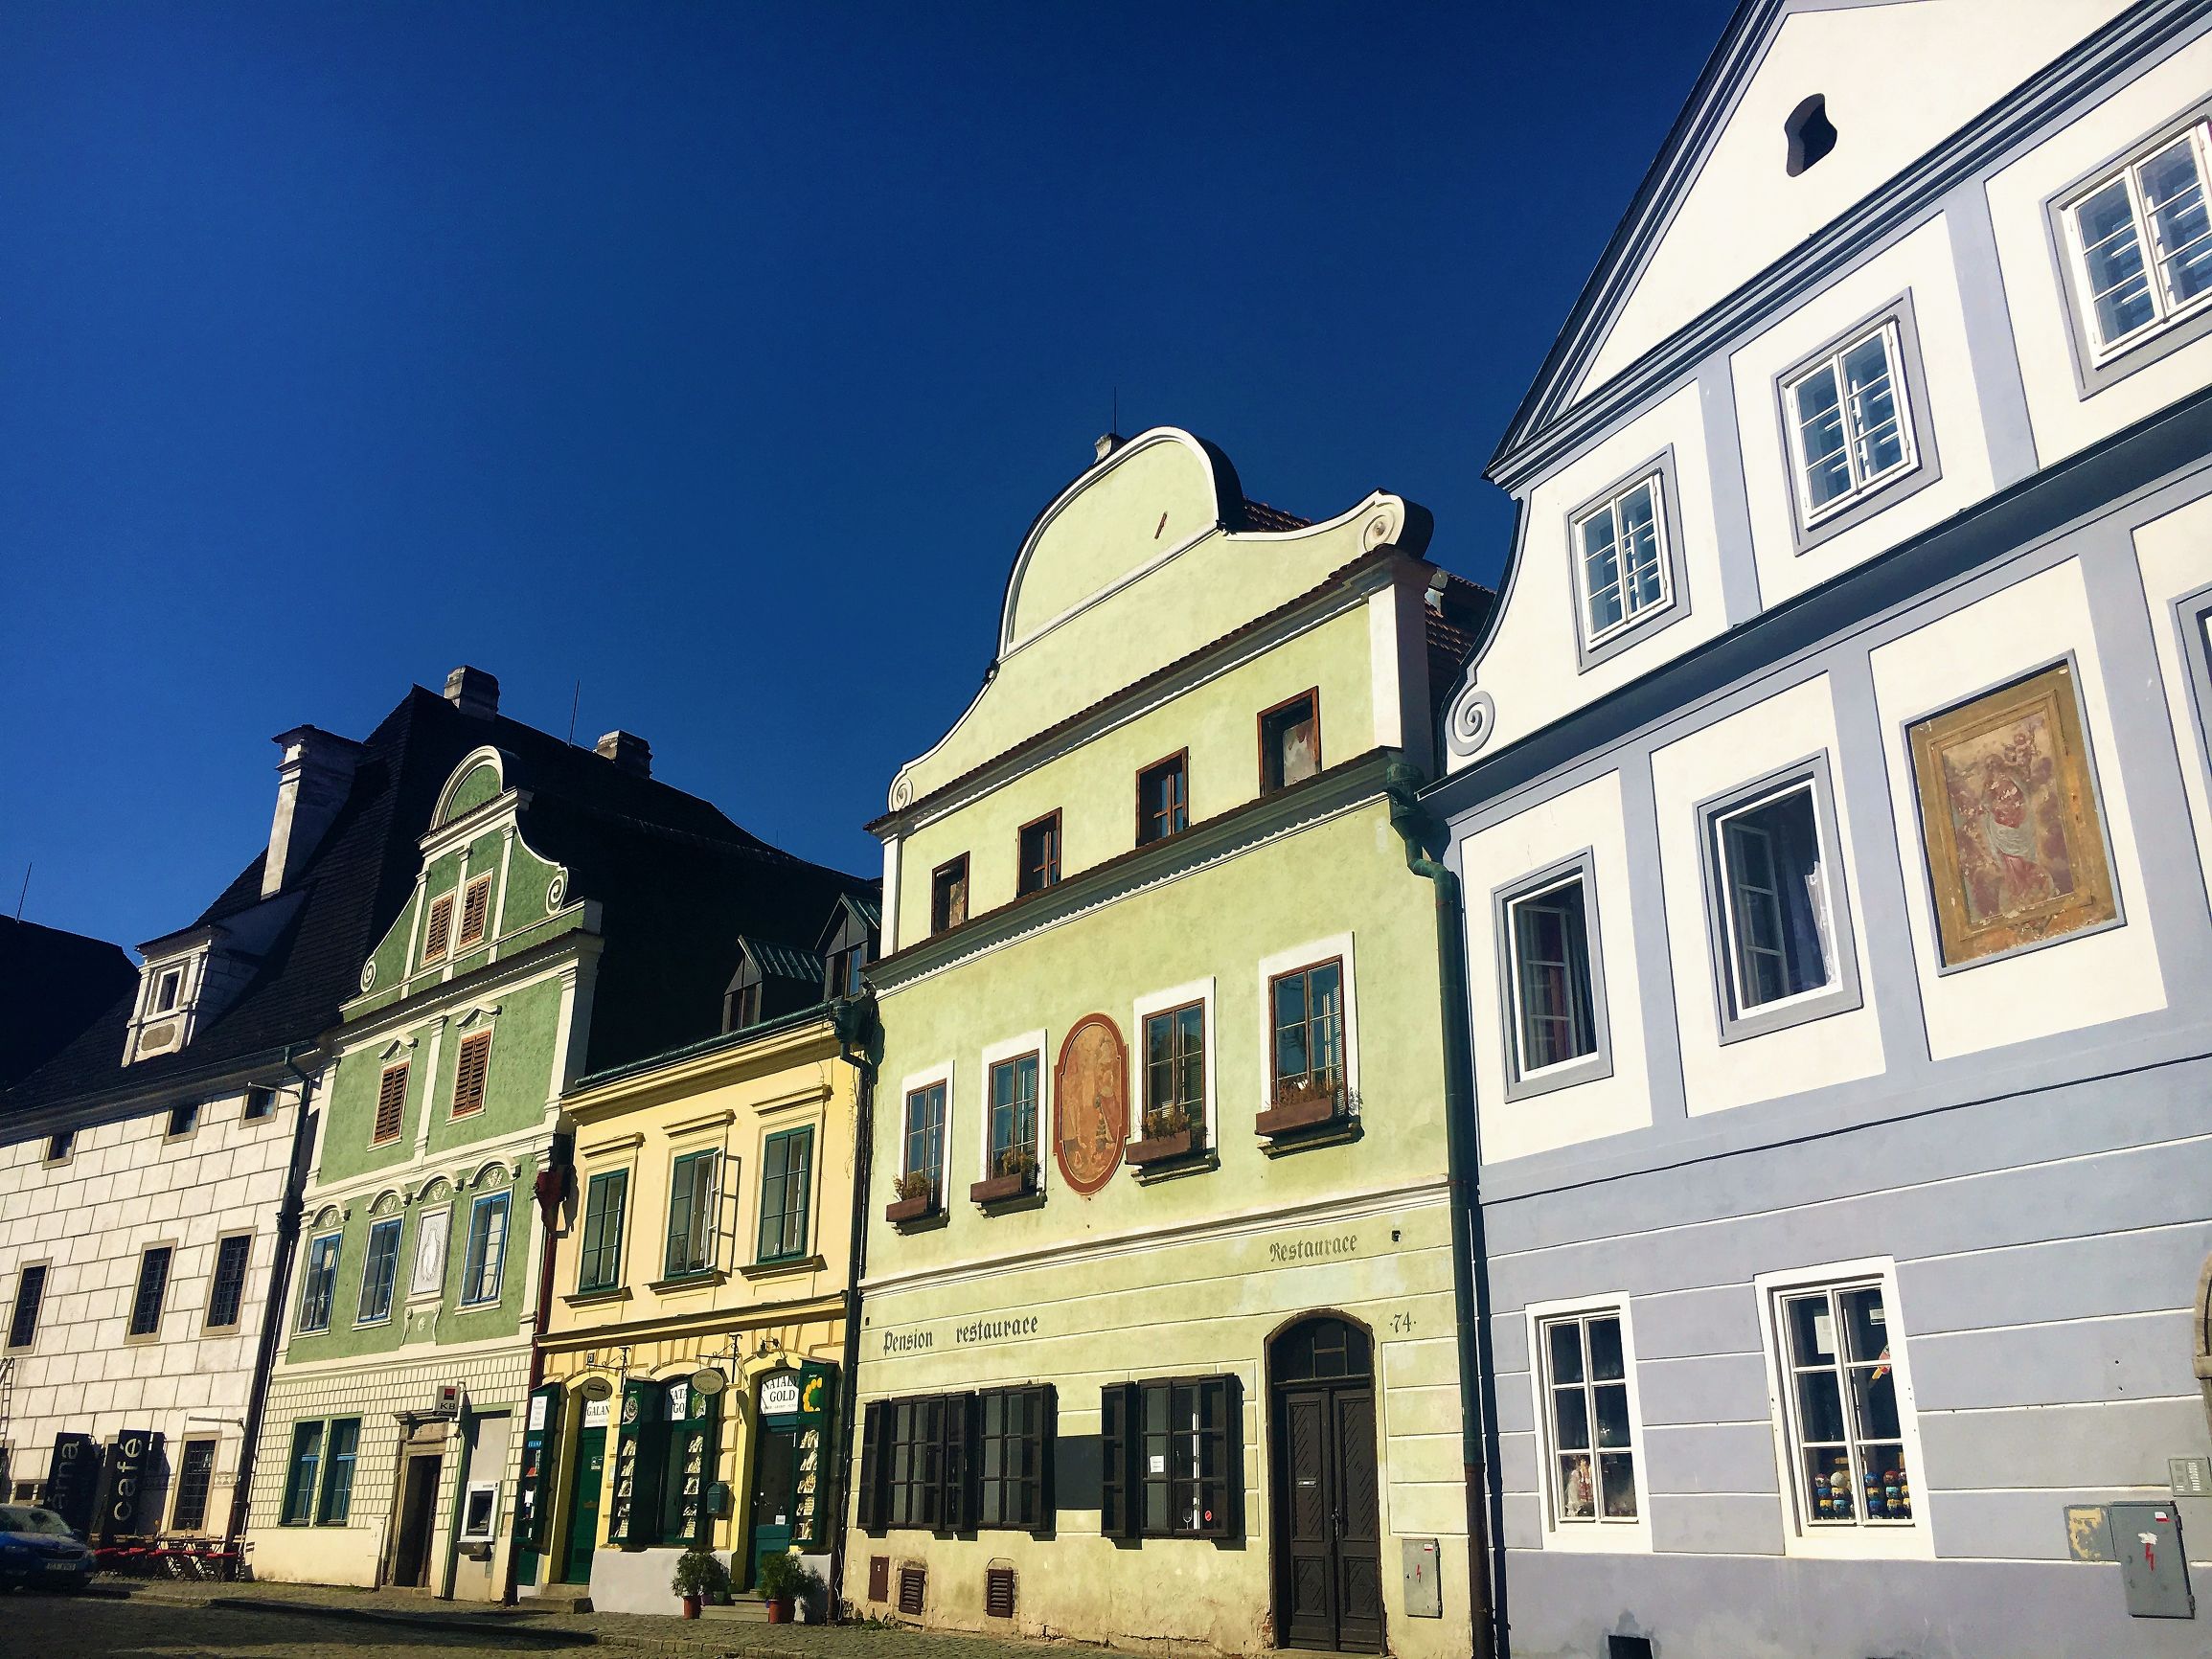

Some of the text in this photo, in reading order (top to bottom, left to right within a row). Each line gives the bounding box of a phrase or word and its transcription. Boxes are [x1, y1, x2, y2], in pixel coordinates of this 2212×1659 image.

[1269, 1235, 1357, 1262] Restaurace
[883, 1316, 1038, 1355] Pension restaurace
[769, 1390, 796, 1402] GOLD
[114, 1436, 144, 1522] café
